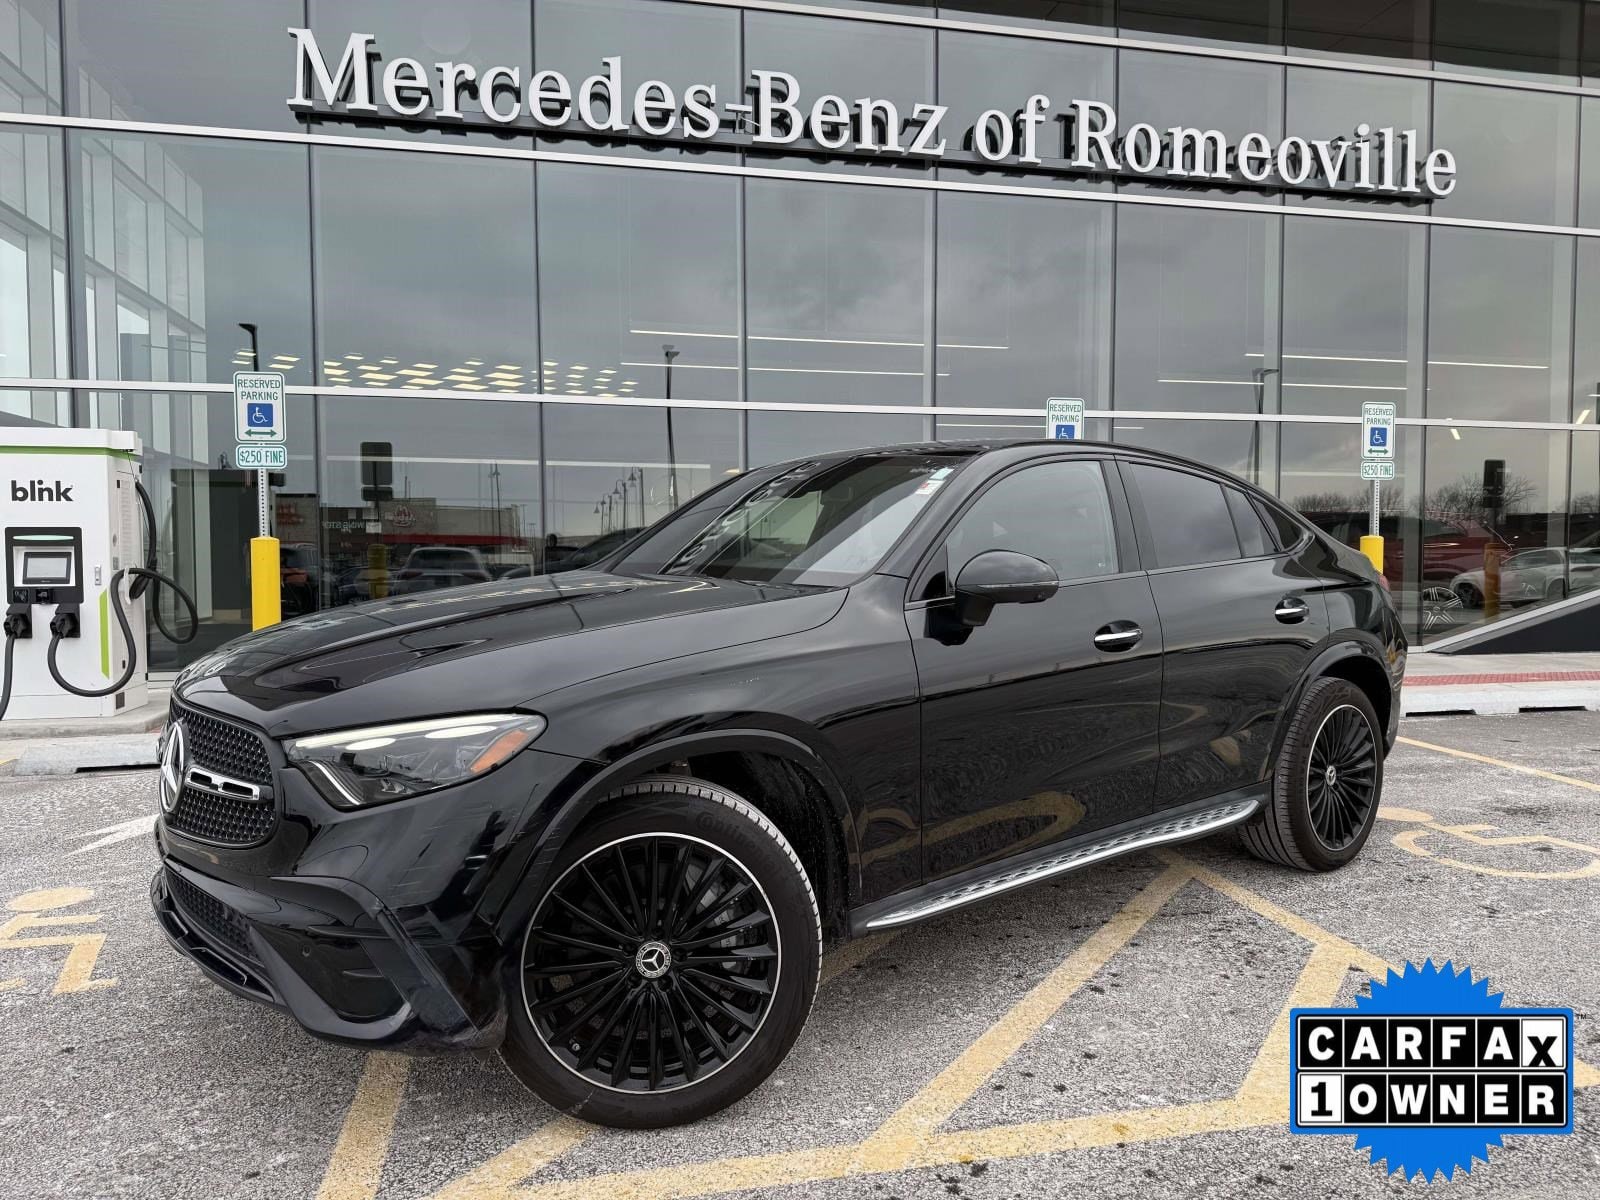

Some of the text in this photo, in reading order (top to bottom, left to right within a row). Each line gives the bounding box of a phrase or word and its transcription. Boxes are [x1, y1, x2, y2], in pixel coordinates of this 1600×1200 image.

[286, 27, 1457, 197] Mercedes-Benz of Romeoville
[237, 379, 281, 389] RESERVED
[240, 391, 279, 401] PARKING
[1049, 404, 1081, 413] RESERVED
[1364, 408, 1393, 416] RESERVED
[1051, 414, 1080, 423] PARKING
[1366, 417, 1392, 425] PARKING
[239, 450, 284, 464] $250 FINE
[1363, 464, 1392, 476] $250 FINE
[11, 479, 74, 502] blink
